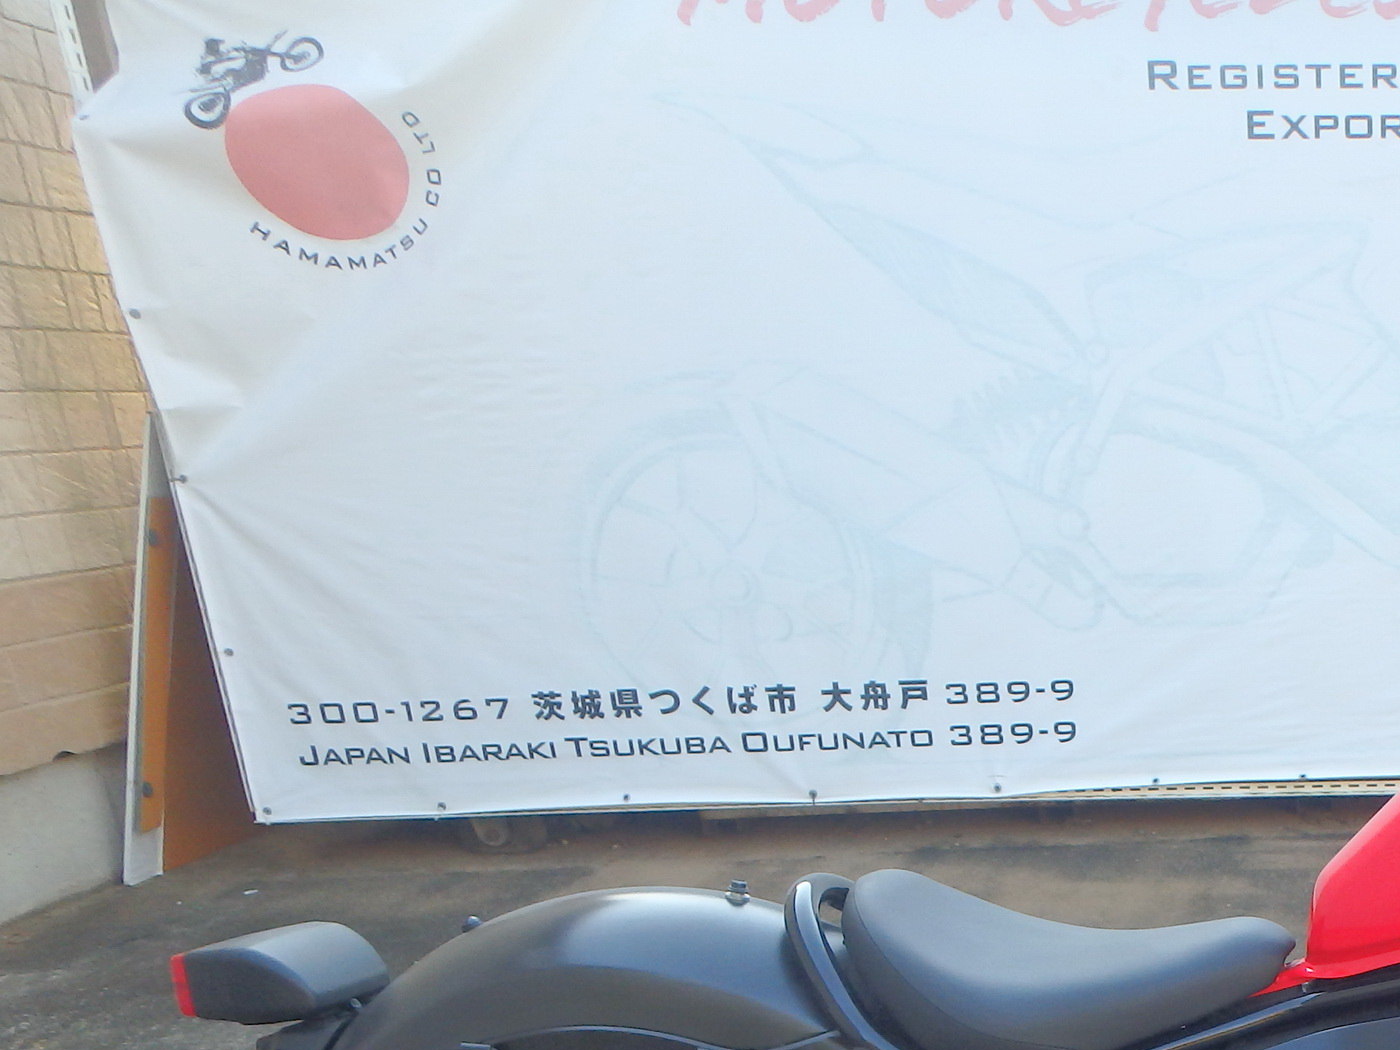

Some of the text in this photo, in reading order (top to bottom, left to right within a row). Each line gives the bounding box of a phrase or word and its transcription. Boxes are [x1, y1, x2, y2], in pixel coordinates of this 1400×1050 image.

[250, 111, 442, 270] HAMAMATSU CO LTD
[286, 679, 1075, 725] 300-1267 茨城県つくば市 大舟戸 389-9
[298, 721, 1077, 767] JAPAN IBARAKI TSUKUBA OUFUNATO 389-9
